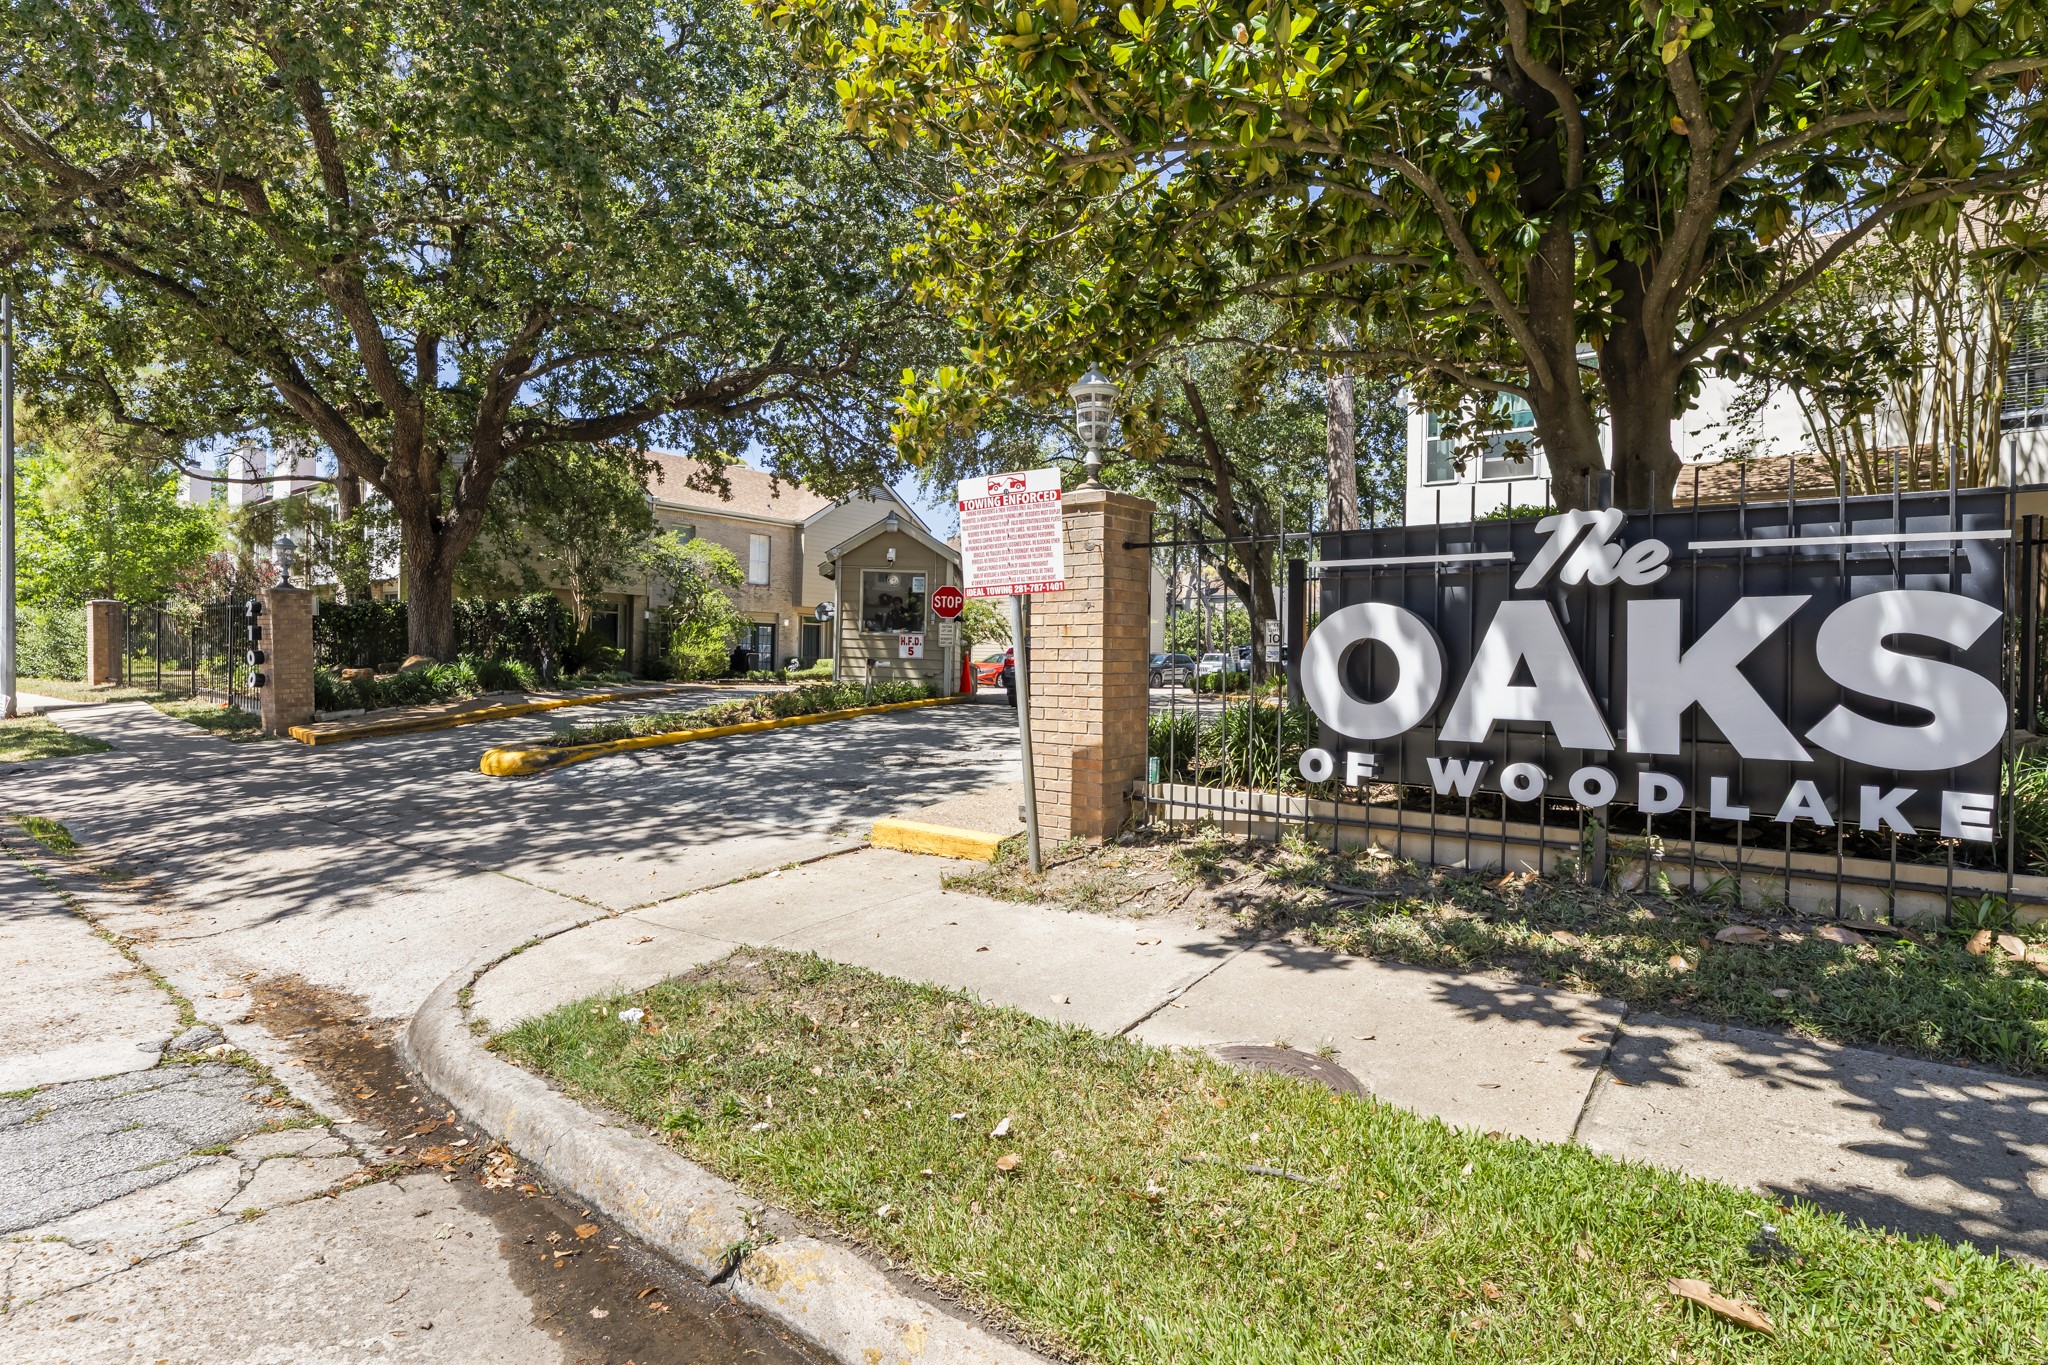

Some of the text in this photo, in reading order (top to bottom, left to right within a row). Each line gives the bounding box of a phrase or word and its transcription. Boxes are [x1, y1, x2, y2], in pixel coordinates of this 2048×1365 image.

[963, 491, 1057, 510] TOWING ENFORCED
[1515, 508, 1671, 590] The
[966, 582, 1063, 596] IDEAL TOWING 281-787-1401
[934, 596, 962, 608] STOP
[900, 636, 922, 646] H.F.D.
[1269, 634, 1280, 644] 10
[908, 647, 914, 656] 5
[1301, 589, 2008, 771] OAKS
[1299, 748, 1995, 843] OF WOODLAKE
